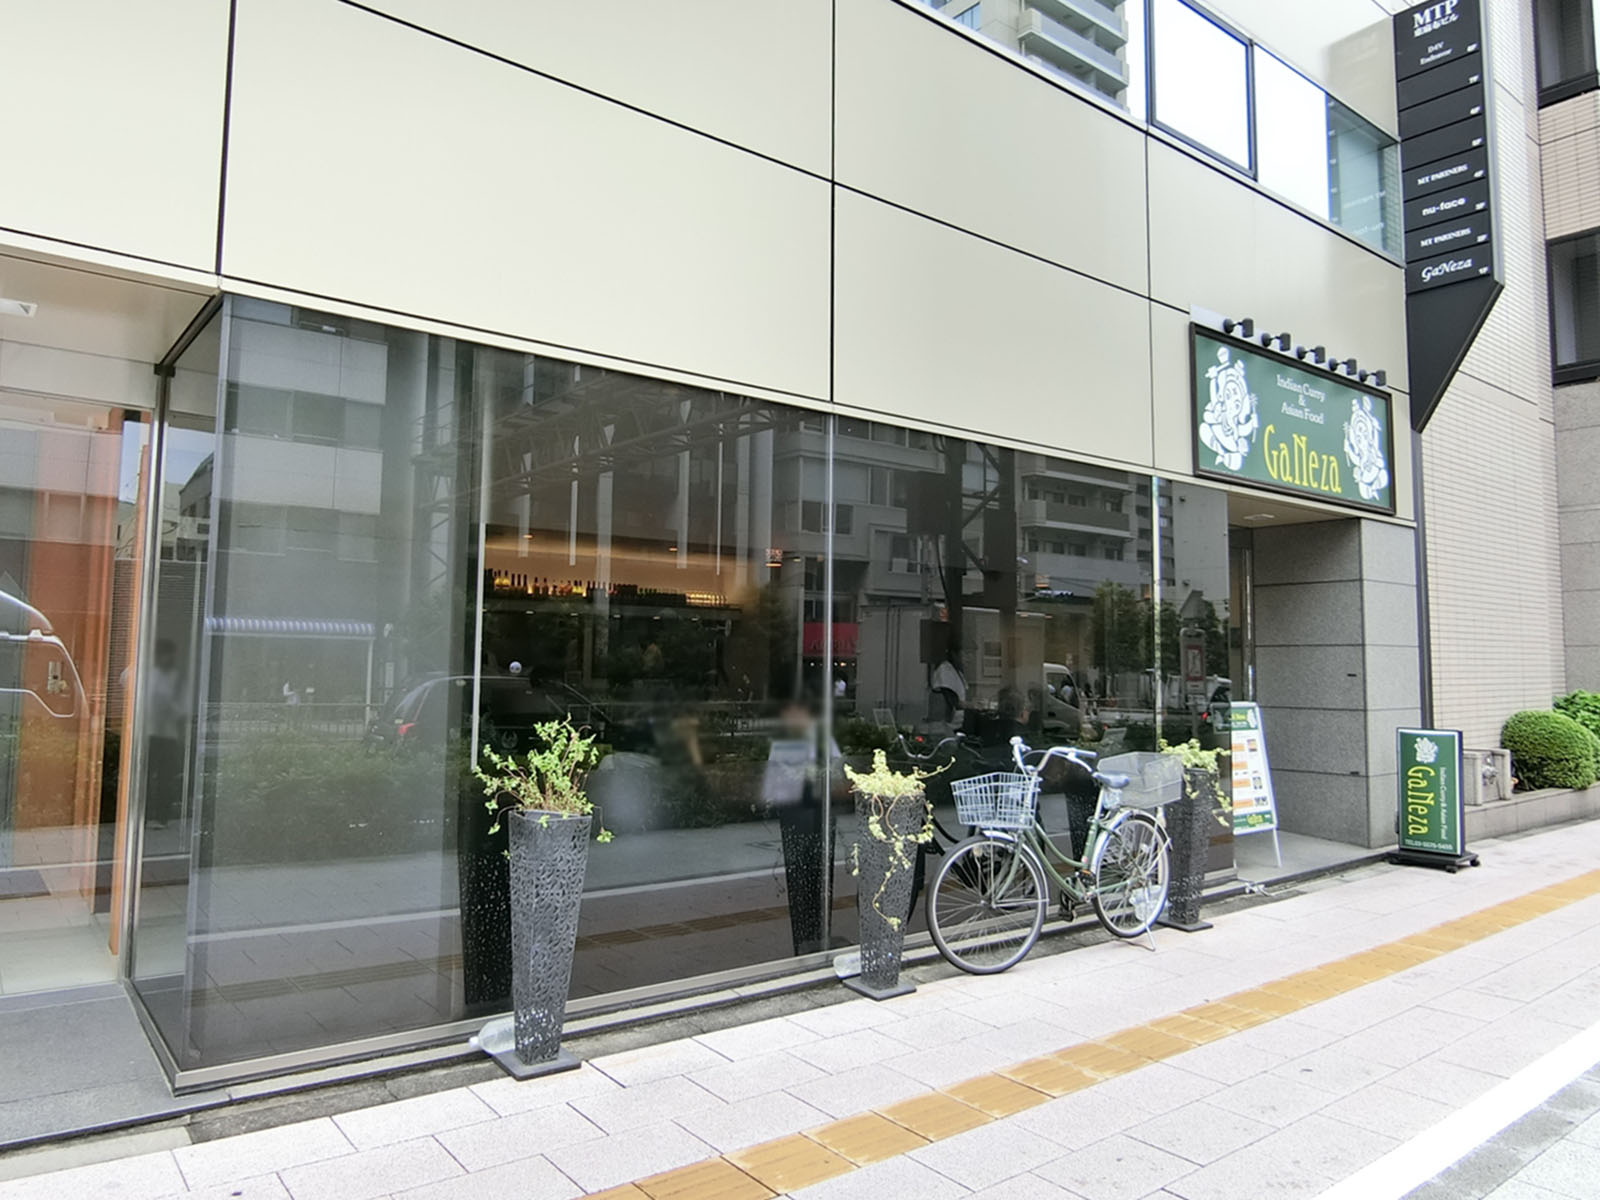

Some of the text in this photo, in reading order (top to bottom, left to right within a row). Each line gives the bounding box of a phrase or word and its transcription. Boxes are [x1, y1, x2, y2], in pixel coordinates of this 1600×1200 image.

[1413, 0, 1459, 28] MTP
[1417, 164, 1469, 185] MT PARTNERS
[1422, 197, 1467, 216] nu-face
[1420, 227, 1472, 247] MT PARTNERS
[1421, 258, 1473, 282] GaNeza
[1277, 374, 1326, 402] Indian Curry
[1281, 401, 1325, 425] Asian Food
[1263, 424, 1342, 494] GaNeza
[1407, 765, 1436, 836] GaNeza
